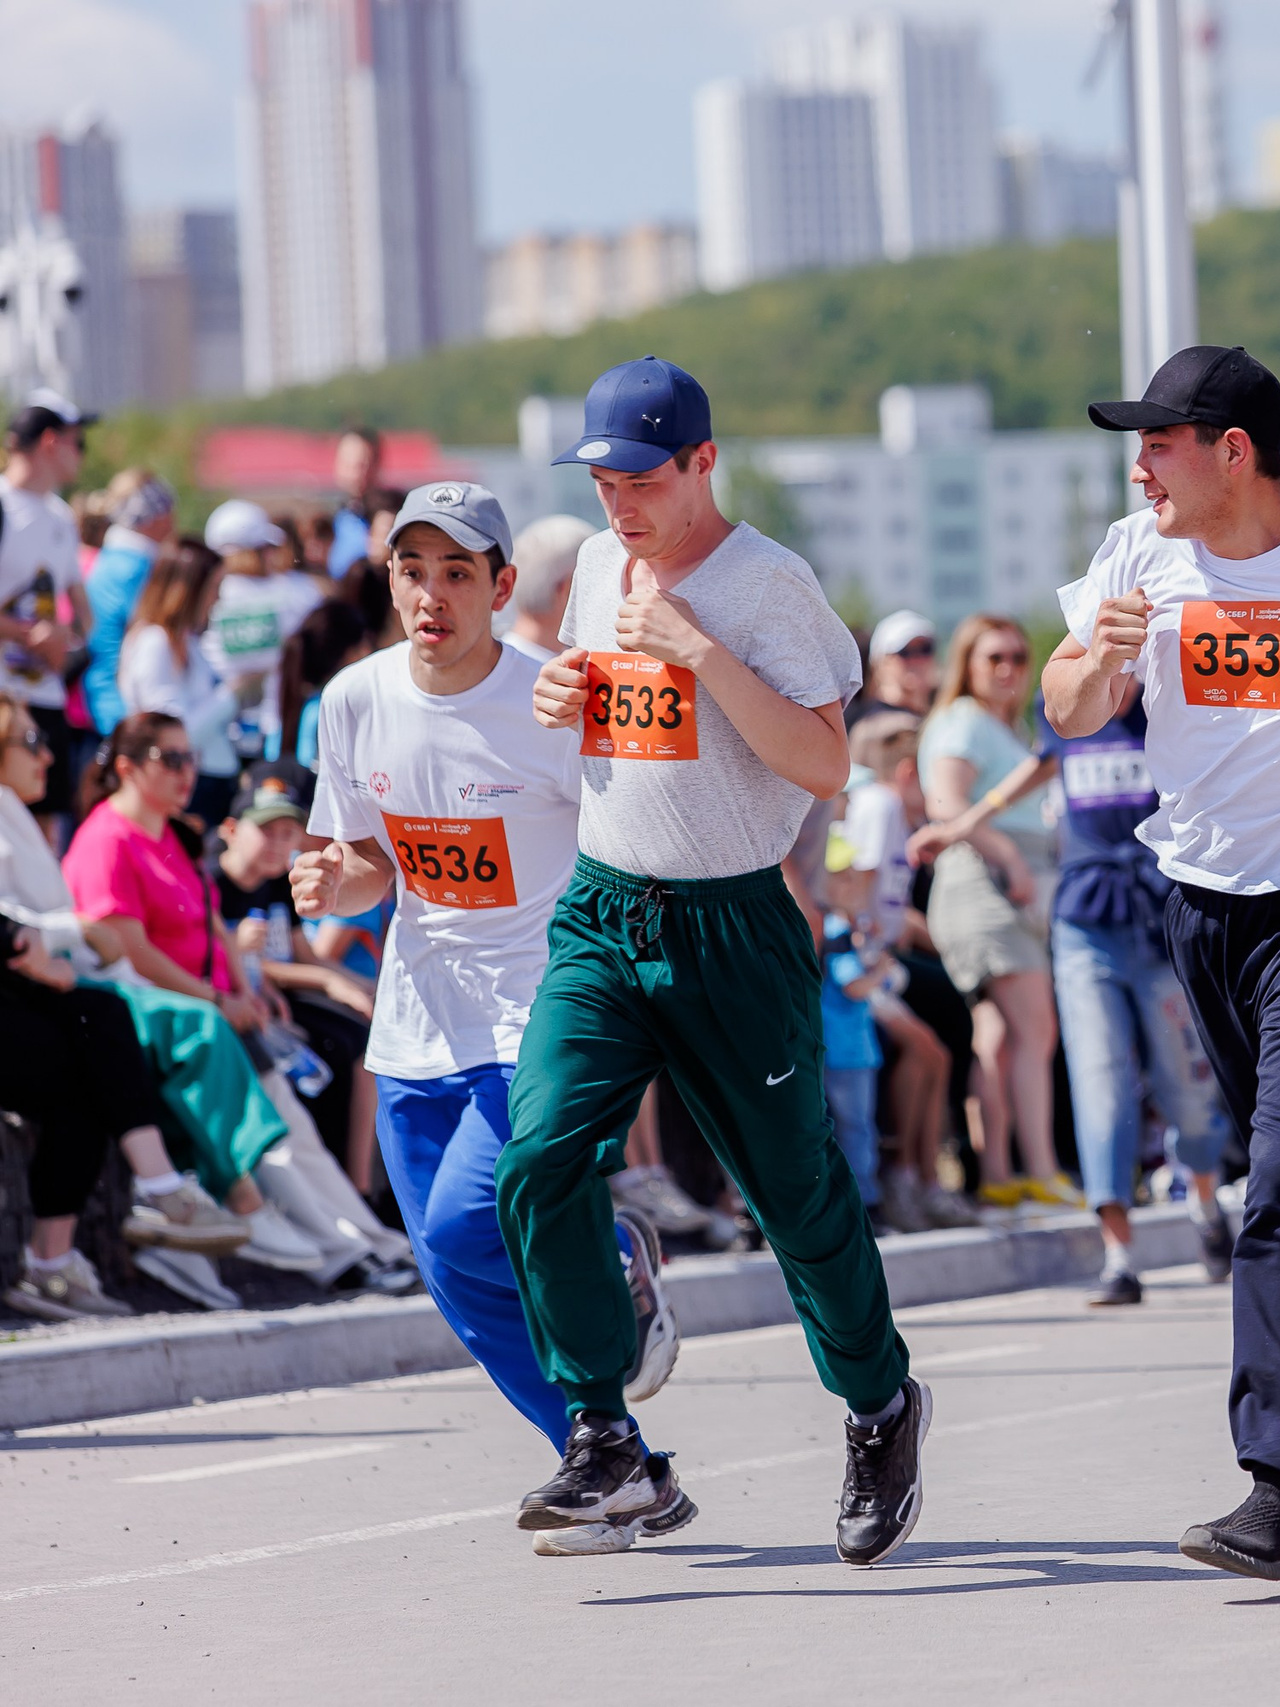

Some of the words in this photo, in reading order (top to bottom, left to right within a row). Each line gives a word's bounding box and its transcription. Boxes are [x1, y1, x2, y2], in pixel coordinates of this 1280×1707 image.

[1226, 610, 1247, 618] СБЕР
[592, 683, 683, 730] 3533
[397, 840, 498, 883] 3536
[656, 1513, 677, 1527] ONLY
